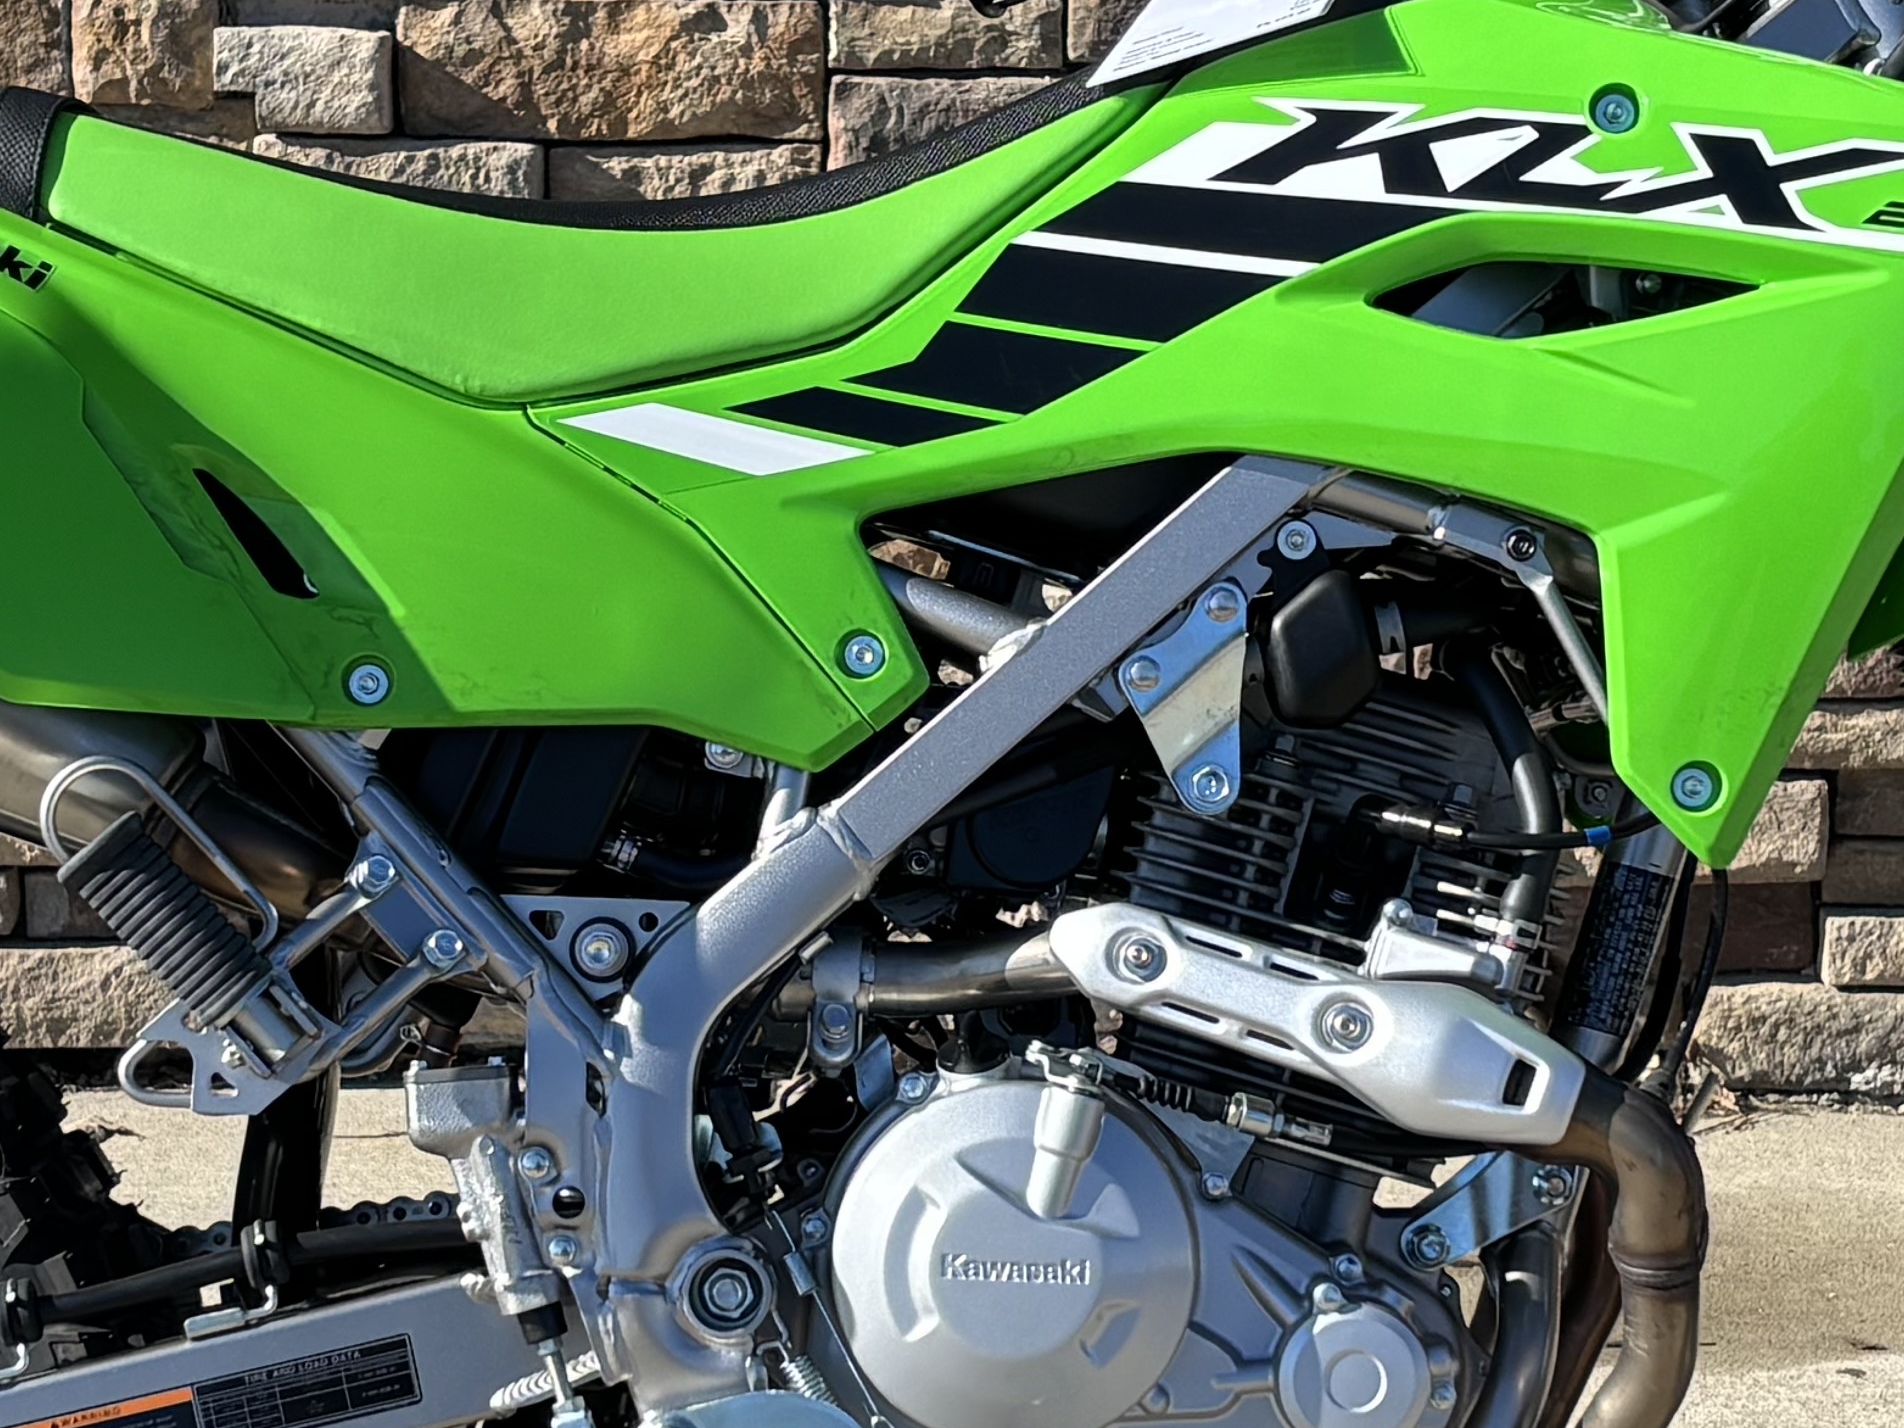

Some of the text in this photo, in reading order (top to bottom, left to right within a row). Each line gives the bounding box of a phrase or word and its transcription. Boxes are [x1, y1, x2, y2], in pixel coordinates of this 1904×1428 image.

[939, 1252, 1092, 1287] Kawasaki
[331, 1349, 362, 1365] DATA
[59, 1404, 123, 1428] WARNING
